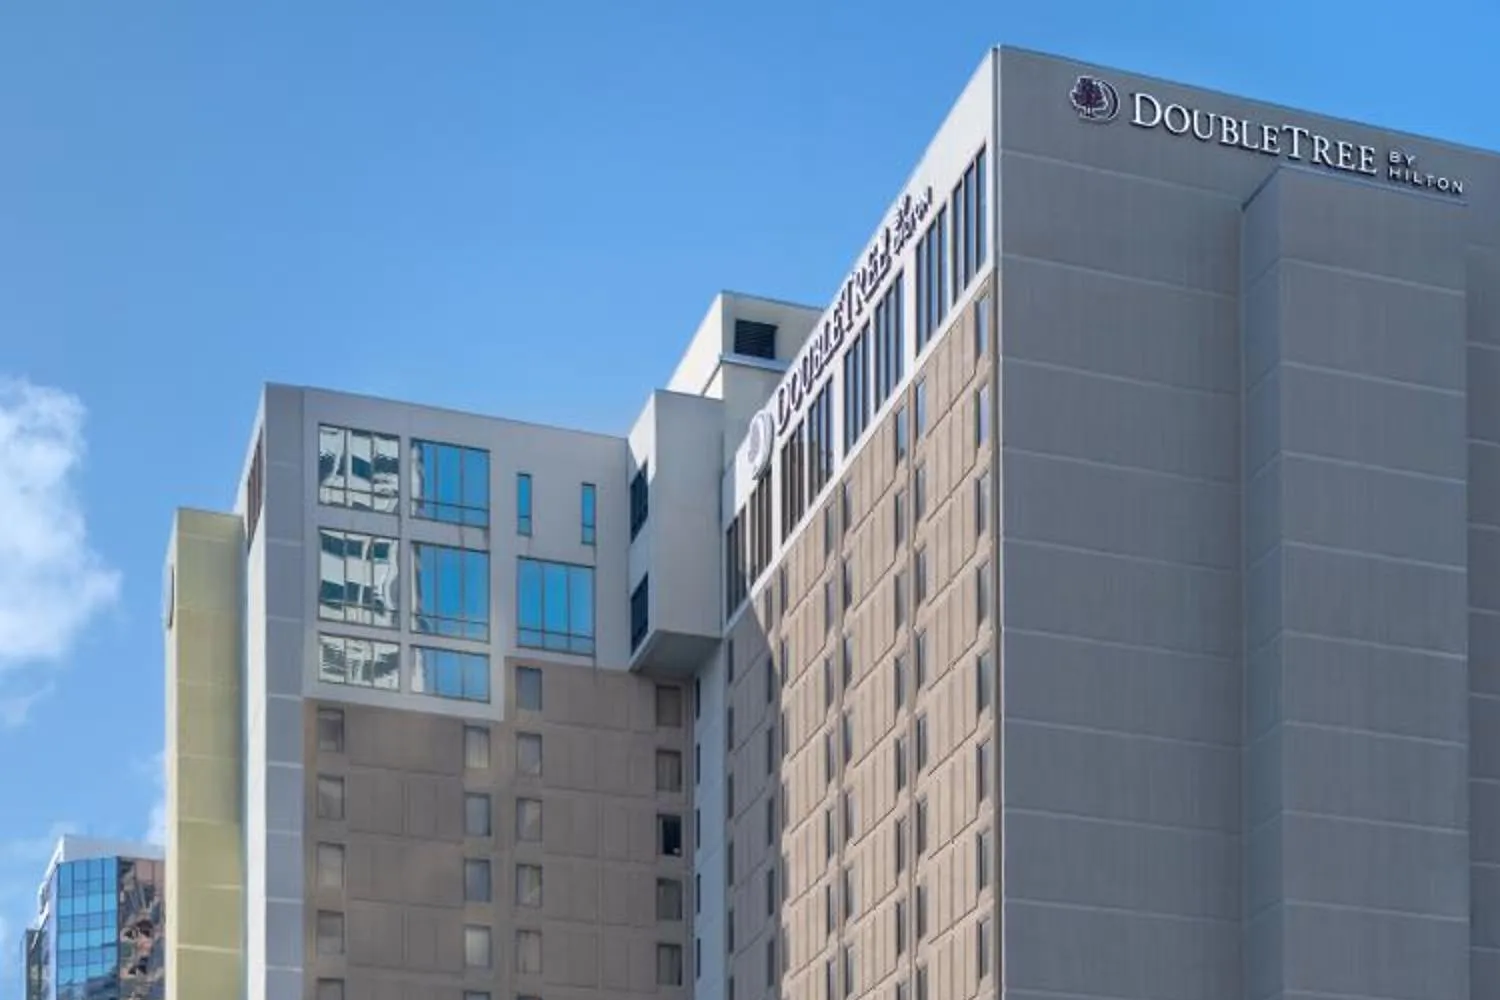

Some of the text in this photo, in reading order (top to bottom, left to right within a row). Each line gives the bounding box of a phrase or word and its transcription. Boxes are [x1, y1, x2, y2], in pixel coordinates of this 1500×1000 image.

[1132, 92, 1378, 174] DOUBLETREE
[1388, 151, 1416, 165] BY
[1388, 166, 1463, 193] HILTON
